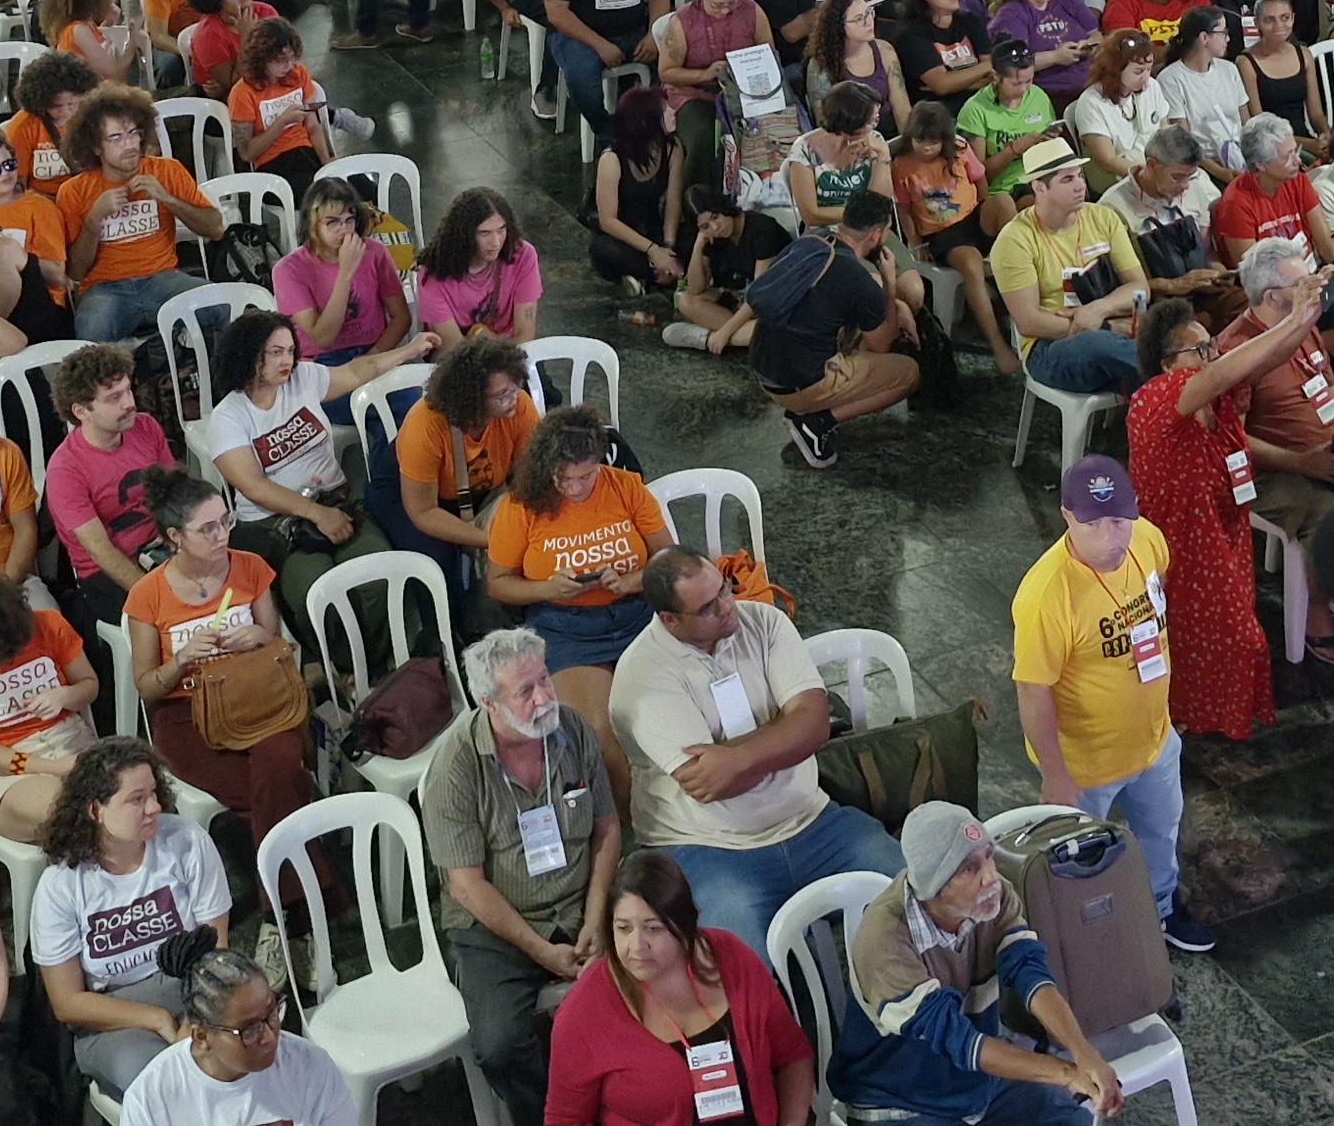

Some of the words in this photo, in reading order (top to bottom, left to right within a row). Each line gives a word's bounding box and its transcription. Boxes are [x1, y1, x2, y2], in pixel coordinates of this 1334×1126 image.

[942, 43, 972, 65] PSTU
[266, 415, 305, 446] nossa
[268, 421, 318, 462] CLASSE
[542, 519, 633, 554] MOVIMENTO
[553, 535, 633, 572] nossa
[91, 909, 178, 955] CLASSE
[94, 896, 160, 936] nossa
